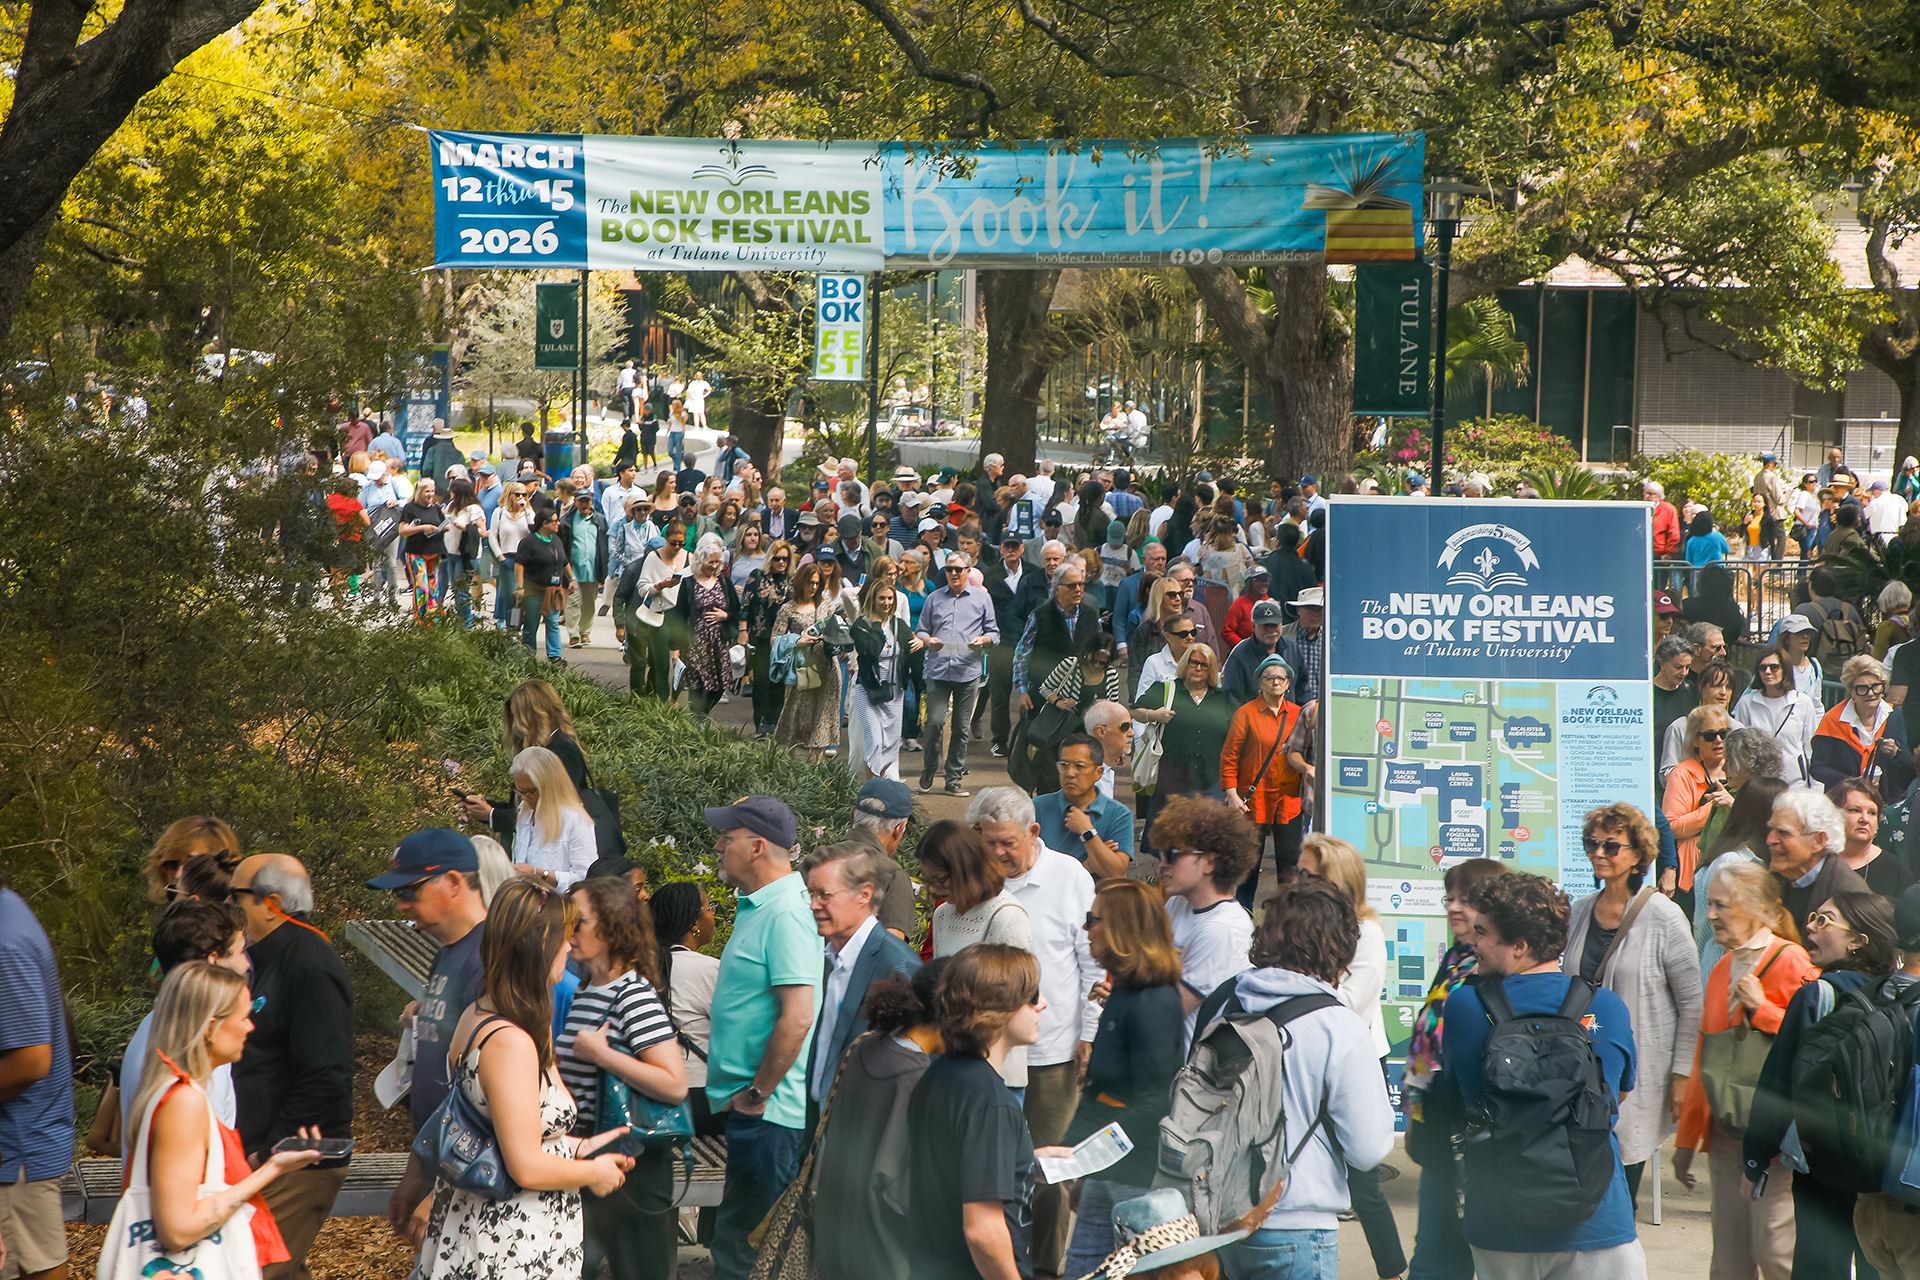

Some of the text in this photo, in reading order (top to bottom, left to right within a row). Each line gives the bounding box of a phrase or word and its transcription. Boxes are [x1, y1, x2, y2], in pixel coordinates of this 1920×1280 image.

[440, 142, 574, 169] MARCH
[441, 175, 574, 212] 12 thru 15
[597, 190, 871, 215] The NEW ORLEANS
[903, 141, 1213, 267] Book it!
[460, 220, 559, 255] 2026
[601, 219, 872, 244] BOOK FESTIVAL
[648, 246, 827, 266] at Tulane University
[1036, 251, 1151, 265] bookfest.tulane.edu
[1225, 250, 1310, 263] @nolabookfest
[539, 343, 576, 352] TULANE
[1398, 278, 1420, 396] TULANE
[1493, 524, 1506, 538] 5
[1361, 593, 1615, 618] The NEW ORLEANS
[1363, 618, 1615, 643] BOOK FESTIVAL
[1403, 644, 1420, 656] at
[1424, 643, 1481, 657] Tulane
[1562, 715, 1644, 724] BOOK FESTIVAL
[1571, 708, 1595, 716] NEW
[1597, 708, 1643, 717] ORLEANS
[1398, 1006, 1412, 1021] 2
